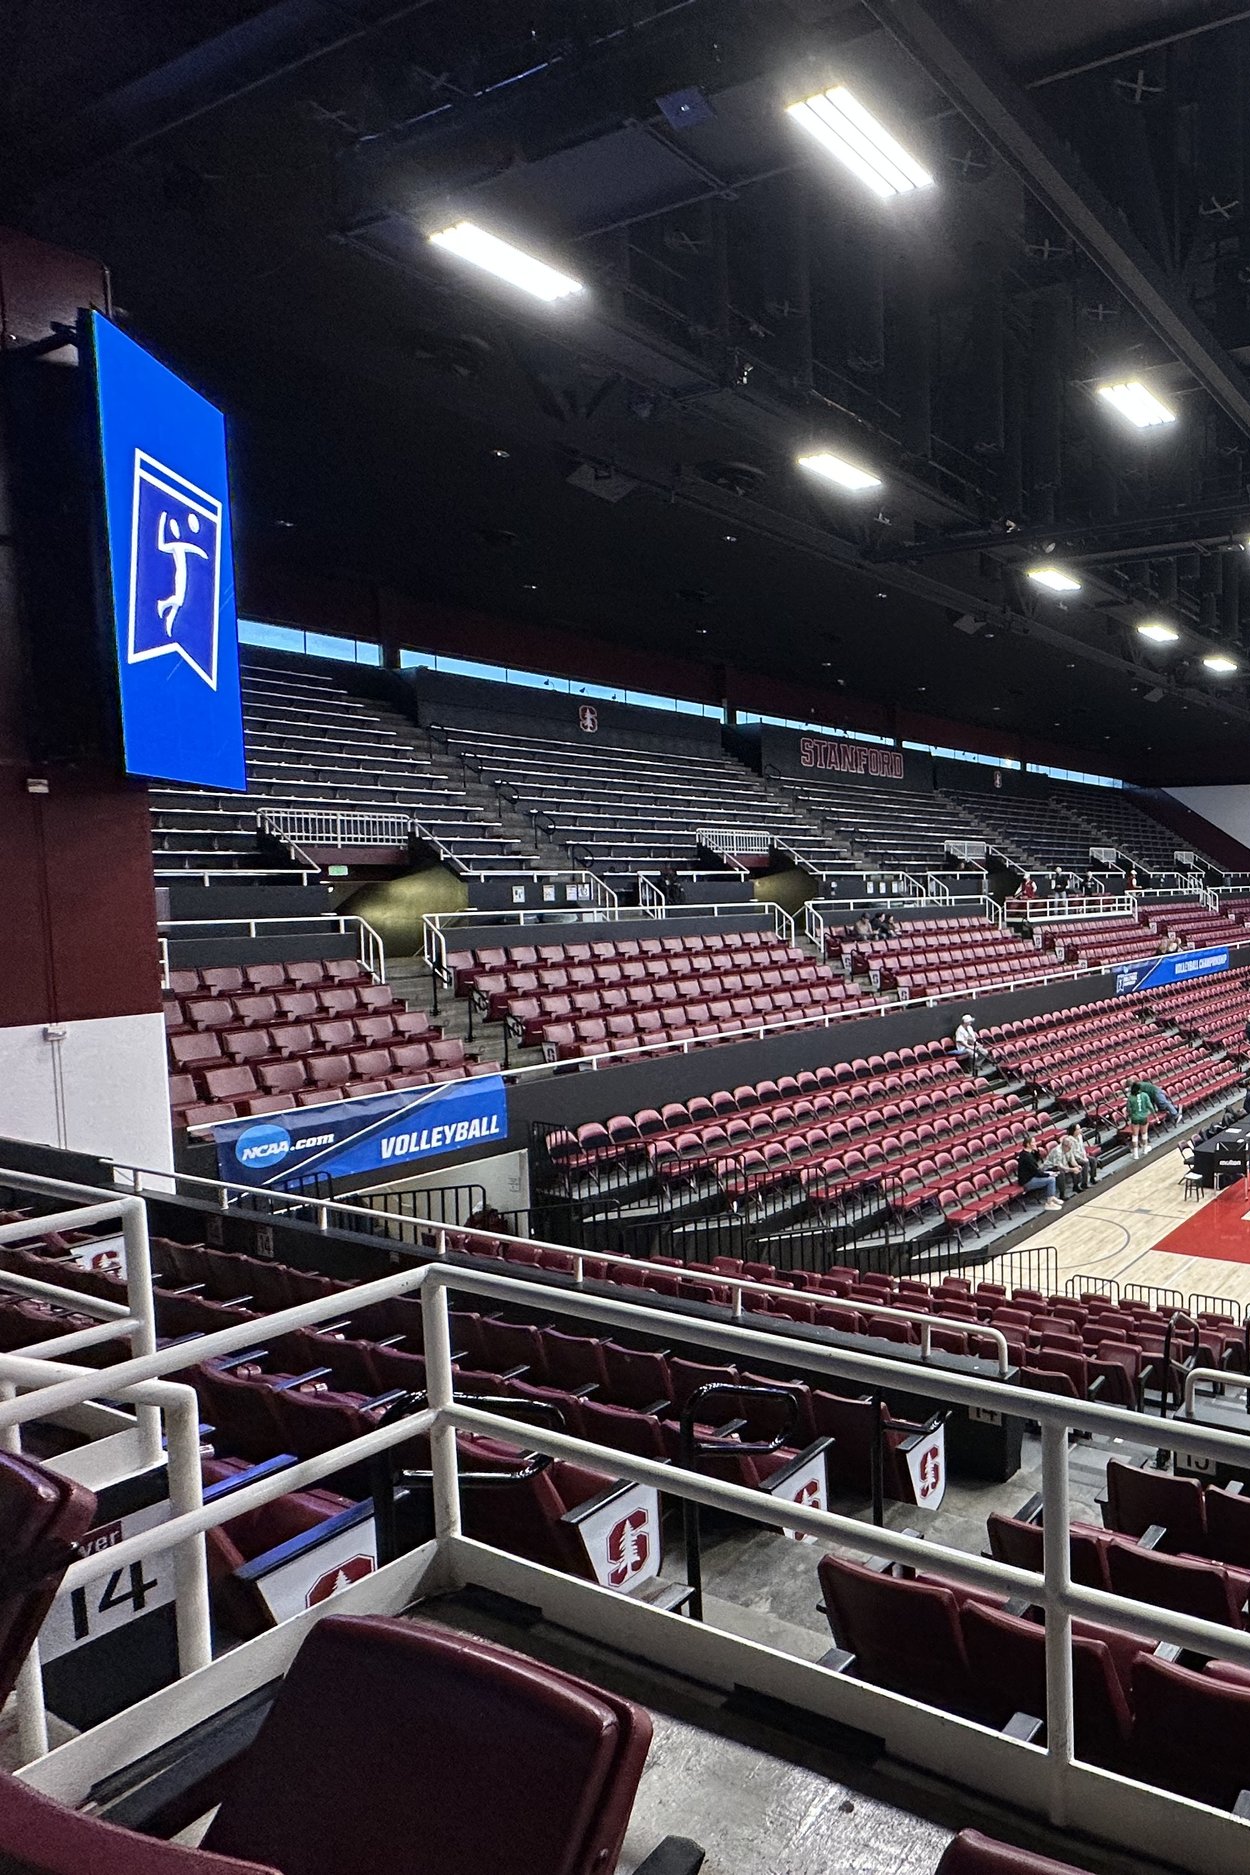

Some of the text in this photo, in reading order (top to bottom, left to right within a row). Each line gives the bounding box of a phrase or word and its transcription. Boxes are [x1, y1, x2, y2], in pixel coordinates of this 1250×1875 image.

[800, 738, 904, 779] STANFORD
[242, 1114, 500, 1161] NCAA.com VOLLEYBALL
[70, 1560, 158, 1641] 14
